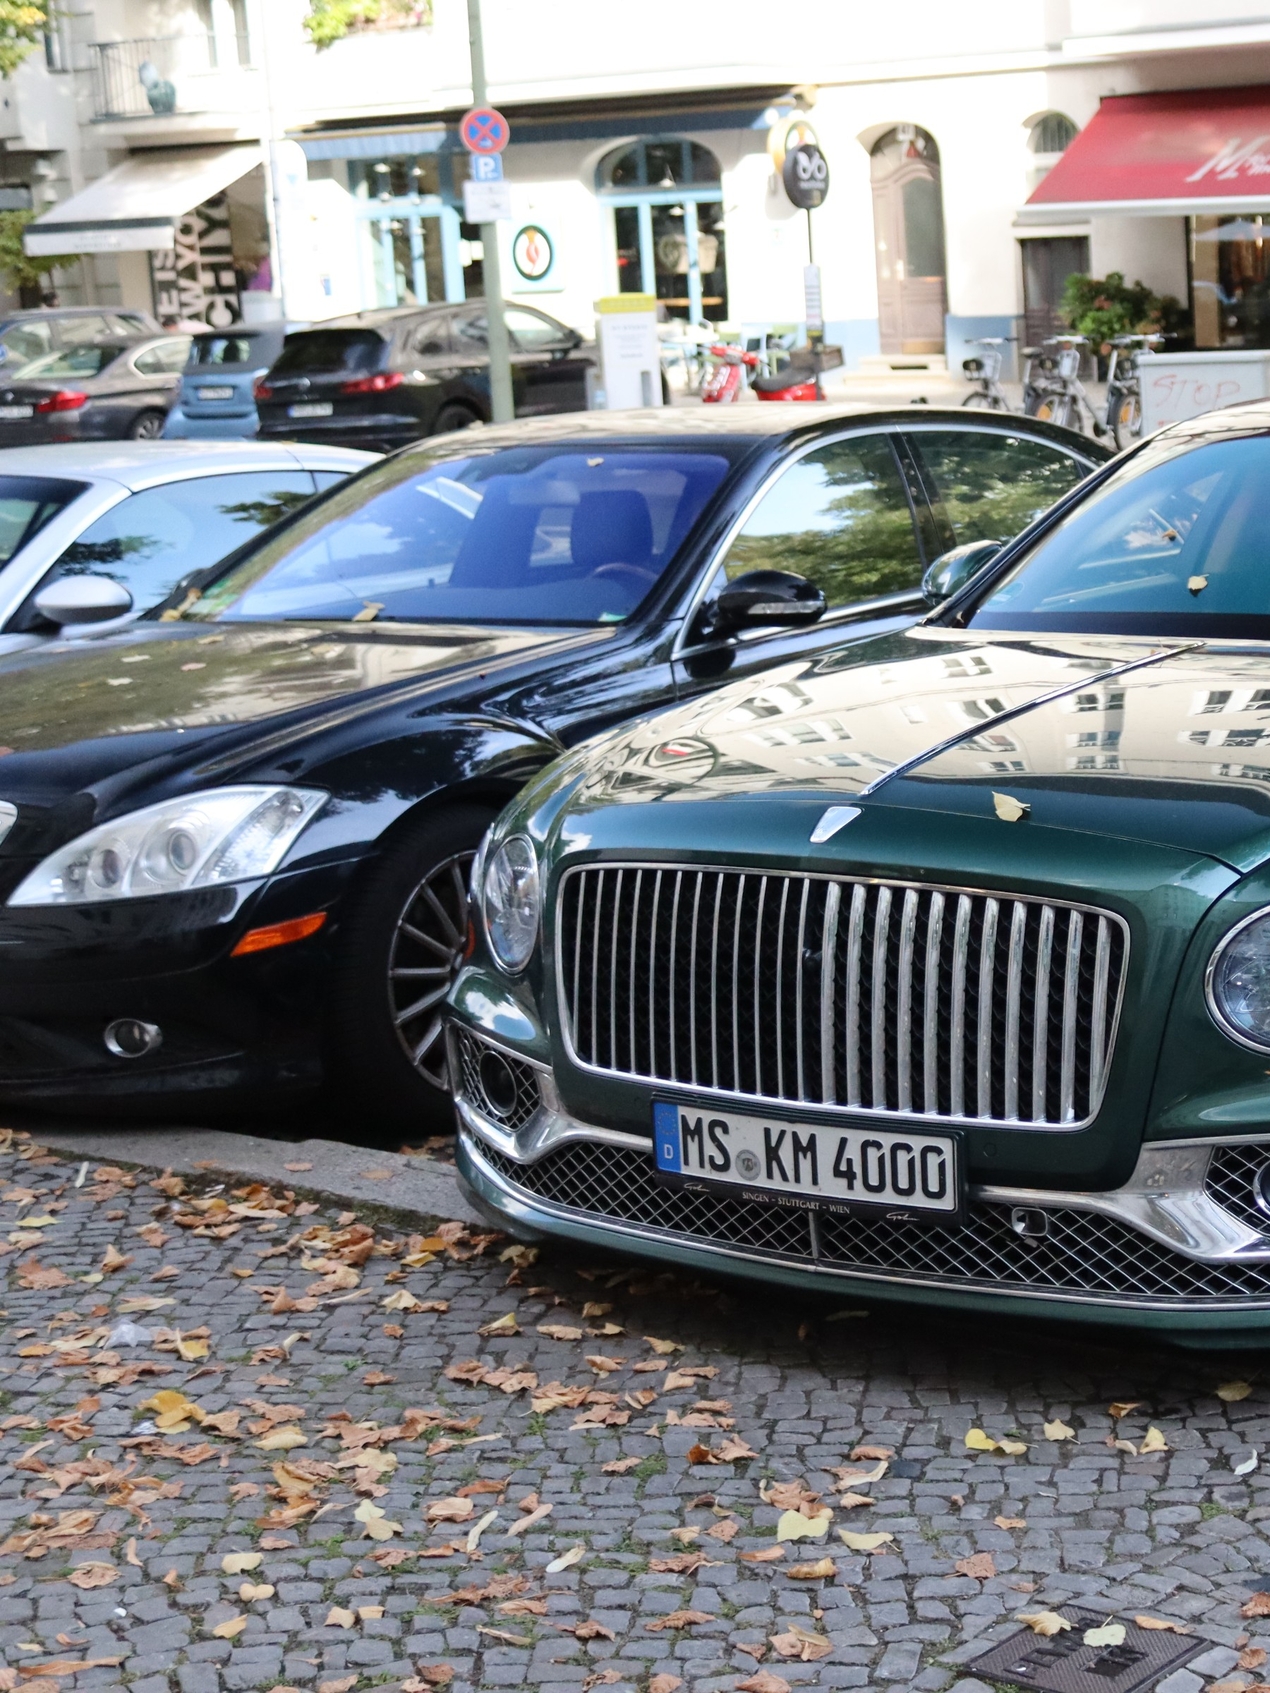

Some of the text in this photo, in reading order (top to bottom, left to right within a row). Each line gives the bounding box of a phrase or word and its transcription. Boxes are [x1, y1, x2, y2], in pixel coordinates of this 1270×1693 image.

[1153, 374, 1241, 410] STOP
[664, 1144, 674, 1160] D
[681, 1114, 948, 1200] MS KM 4000
[742, 1191, 770, 1203] SINGEN
[777, 1196, 821, 1211] STUTTGART
[828, 1204, 850, 1215] WIEN
